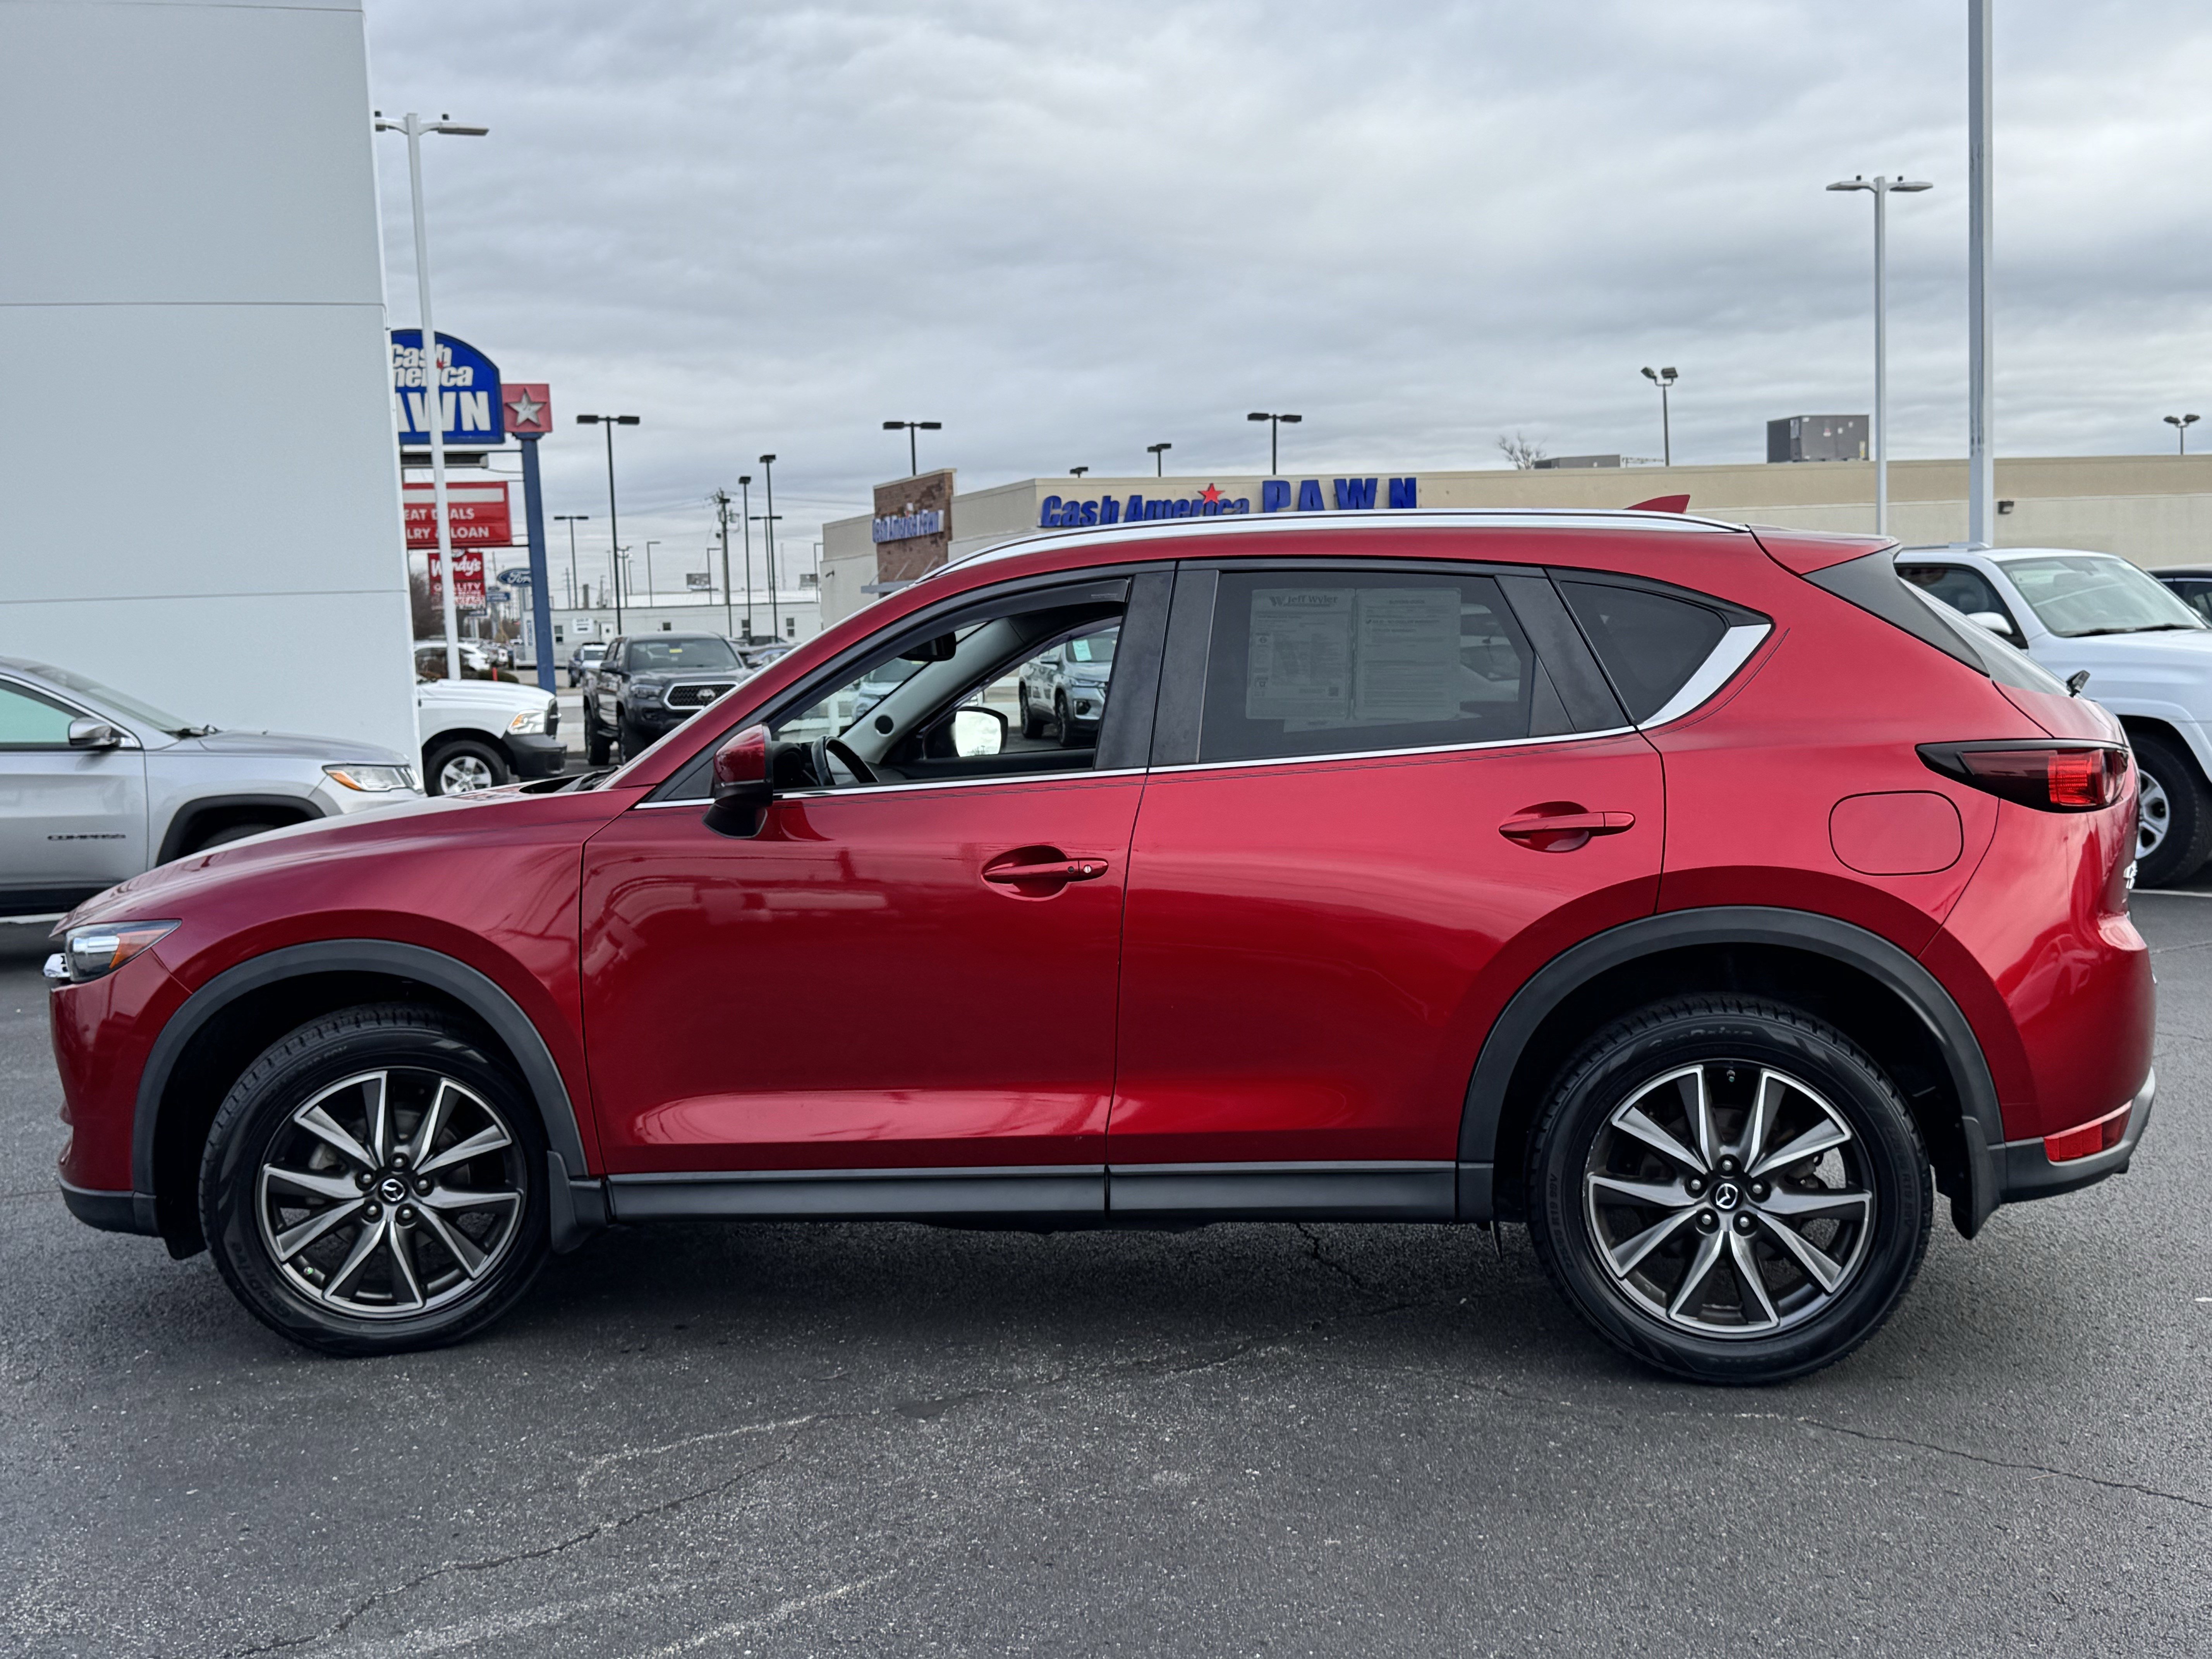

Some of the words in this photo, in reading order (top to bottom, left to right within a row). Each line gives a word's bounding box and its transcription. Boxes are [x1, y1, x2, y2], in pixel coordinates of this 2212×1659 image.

[1041, 495, 1120, 527] Cash
[1262, 478, 1417, 513] PAWN
[431, 507, 475, 520] DALS
[1287, 595, 1307, 603] Jeff
[1308, 594, 1338, 604] Wyler
